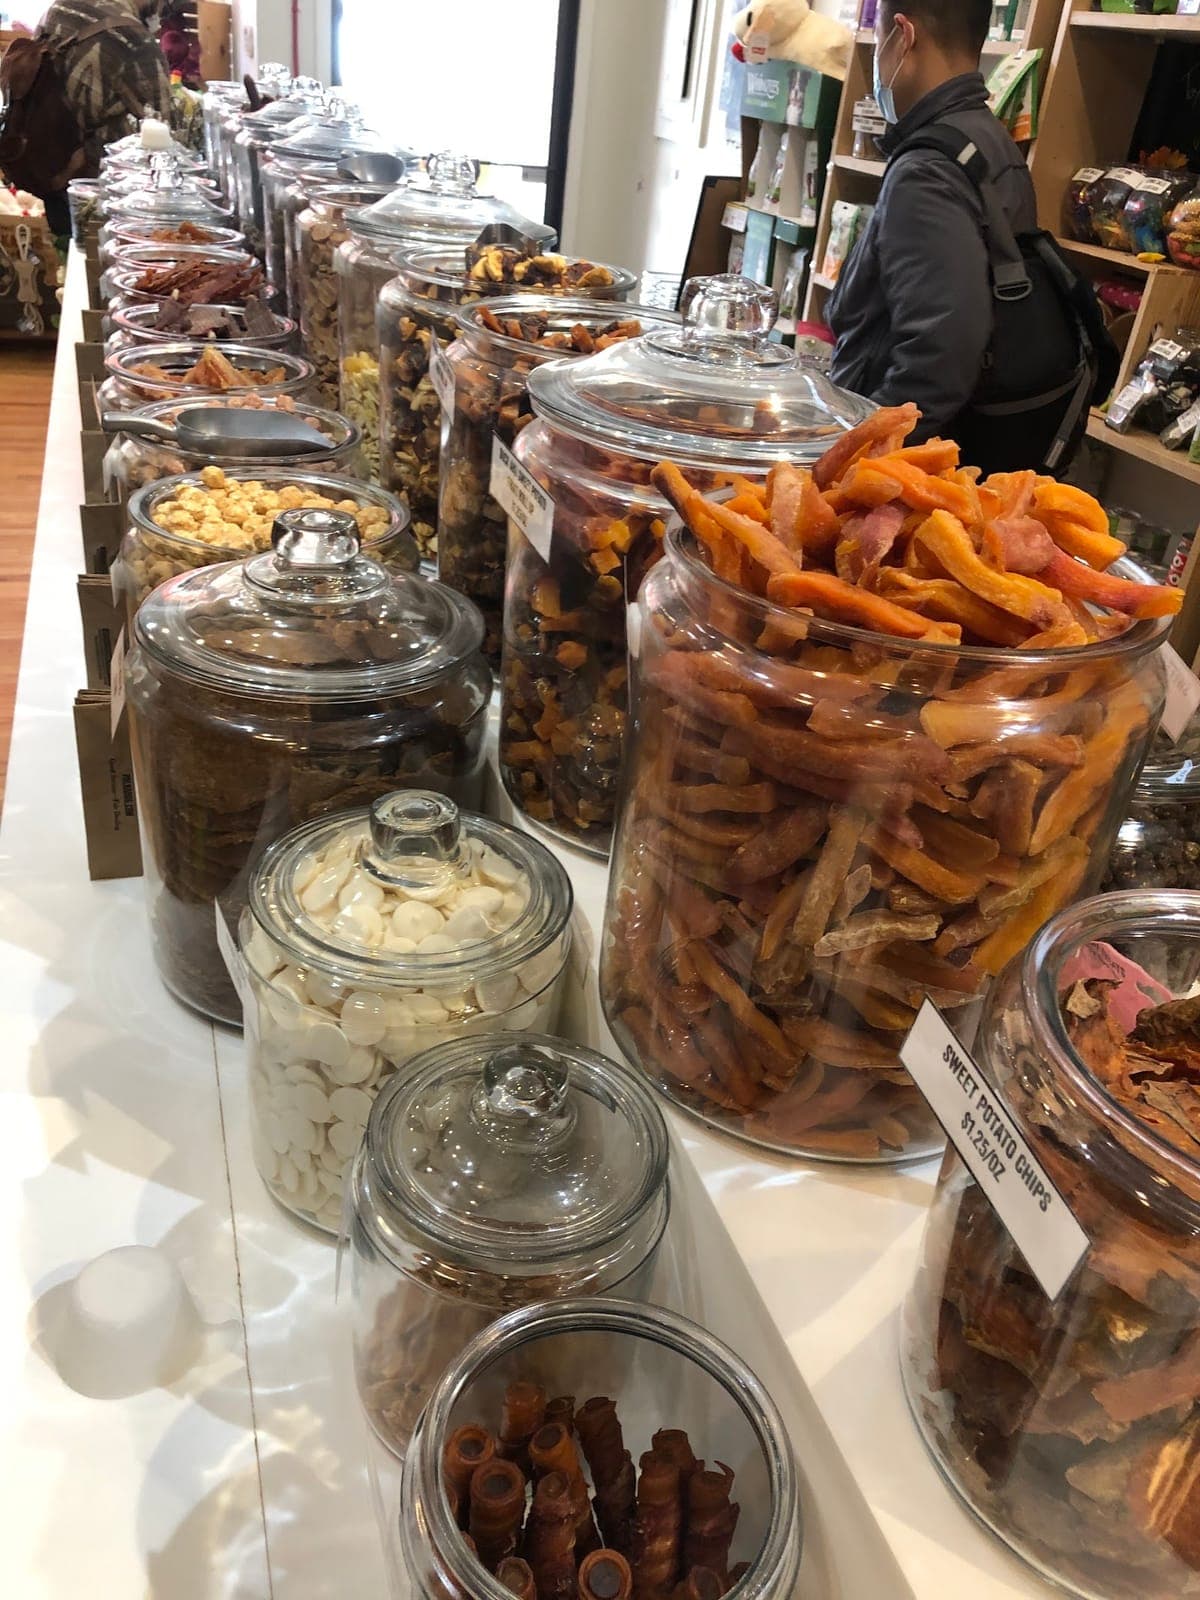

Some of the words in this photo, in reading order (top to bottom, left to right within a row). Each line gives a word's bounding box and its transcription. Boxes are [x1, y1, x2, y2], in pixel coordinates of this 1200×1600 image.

[942, 1044, 979, 1100] SWEET
[976, 1094, 1018, 1160] POTATO
[1015, 1153, 1052, 1213] CHIPS
[961, 1111, 1006, 1184] $1.25/OZ
